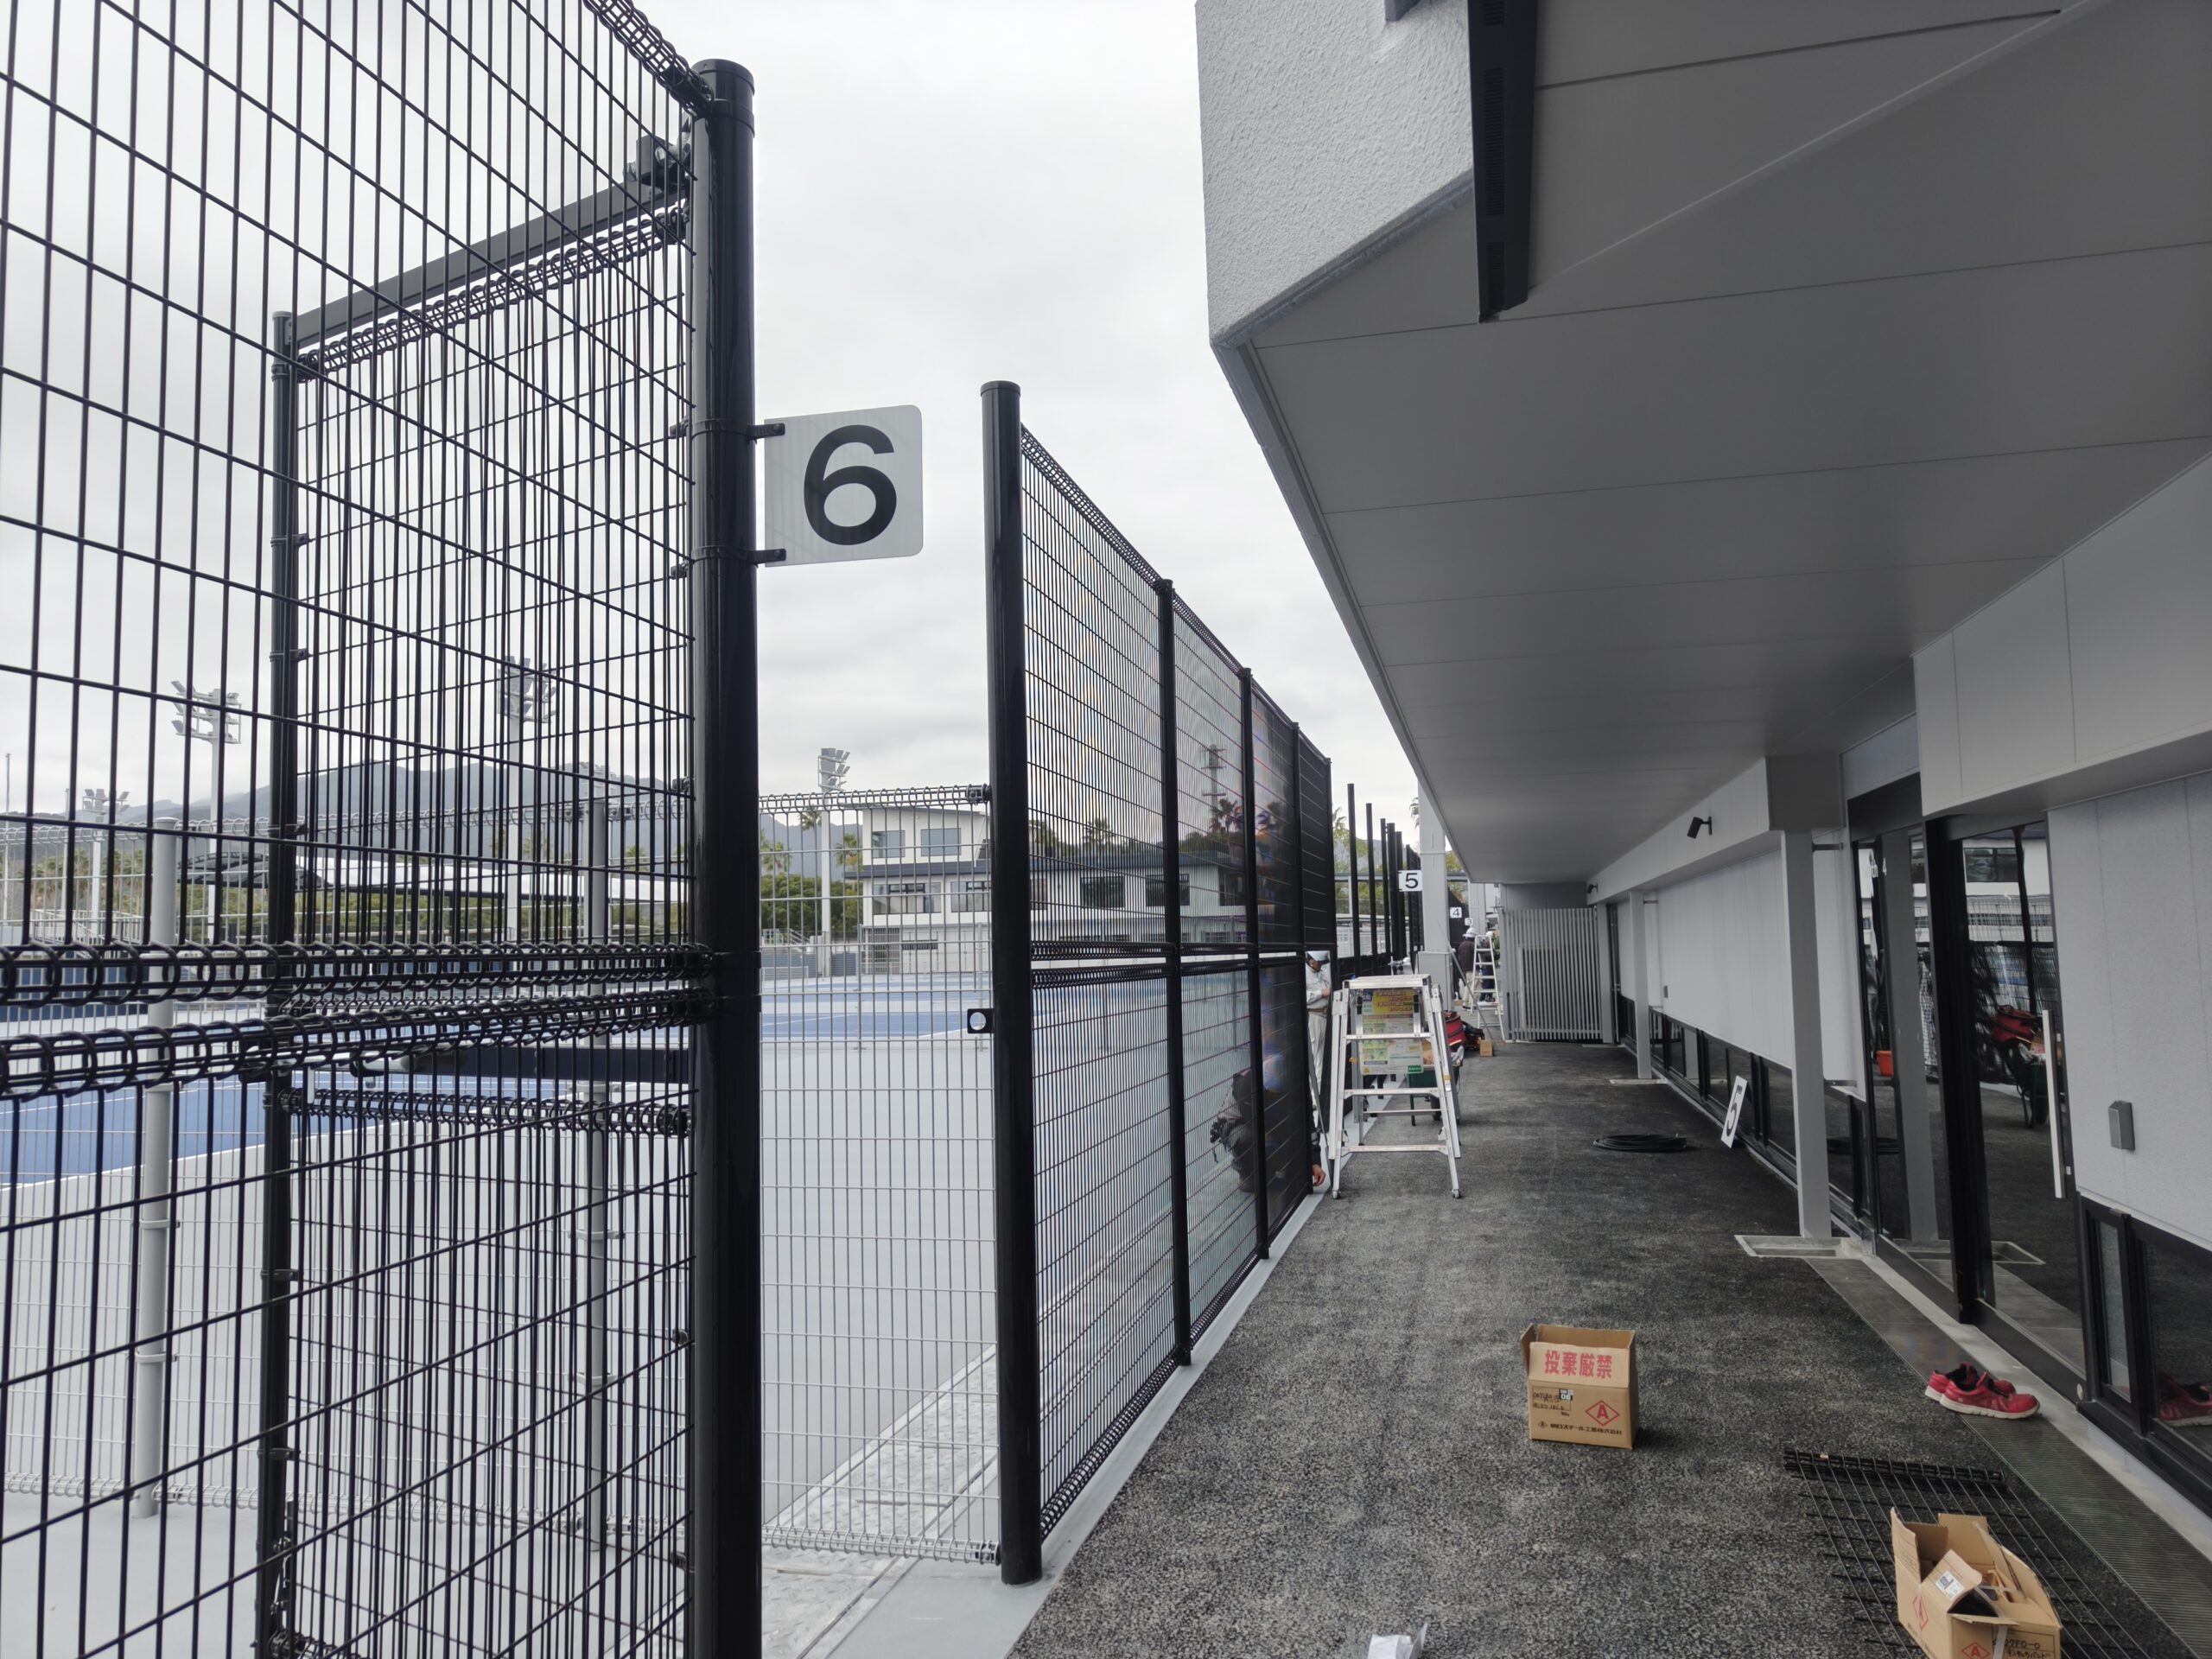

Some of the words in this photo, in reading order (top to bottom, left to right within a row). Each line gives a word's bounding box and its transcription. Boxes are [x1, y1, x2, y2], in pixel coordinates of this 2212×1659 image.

[804, 424, 897, 545] 6
[1405, 872, 1419, 888] 5
[1452, 908, 1459, 917] 4
[1726, 1084, 1743, 1137] 5
[1545, 1350, 1612, 1378] 投棄厳禁
[1597, 1404, 1609, 1420] A
[1971, 1645, 1981, 1657] A
